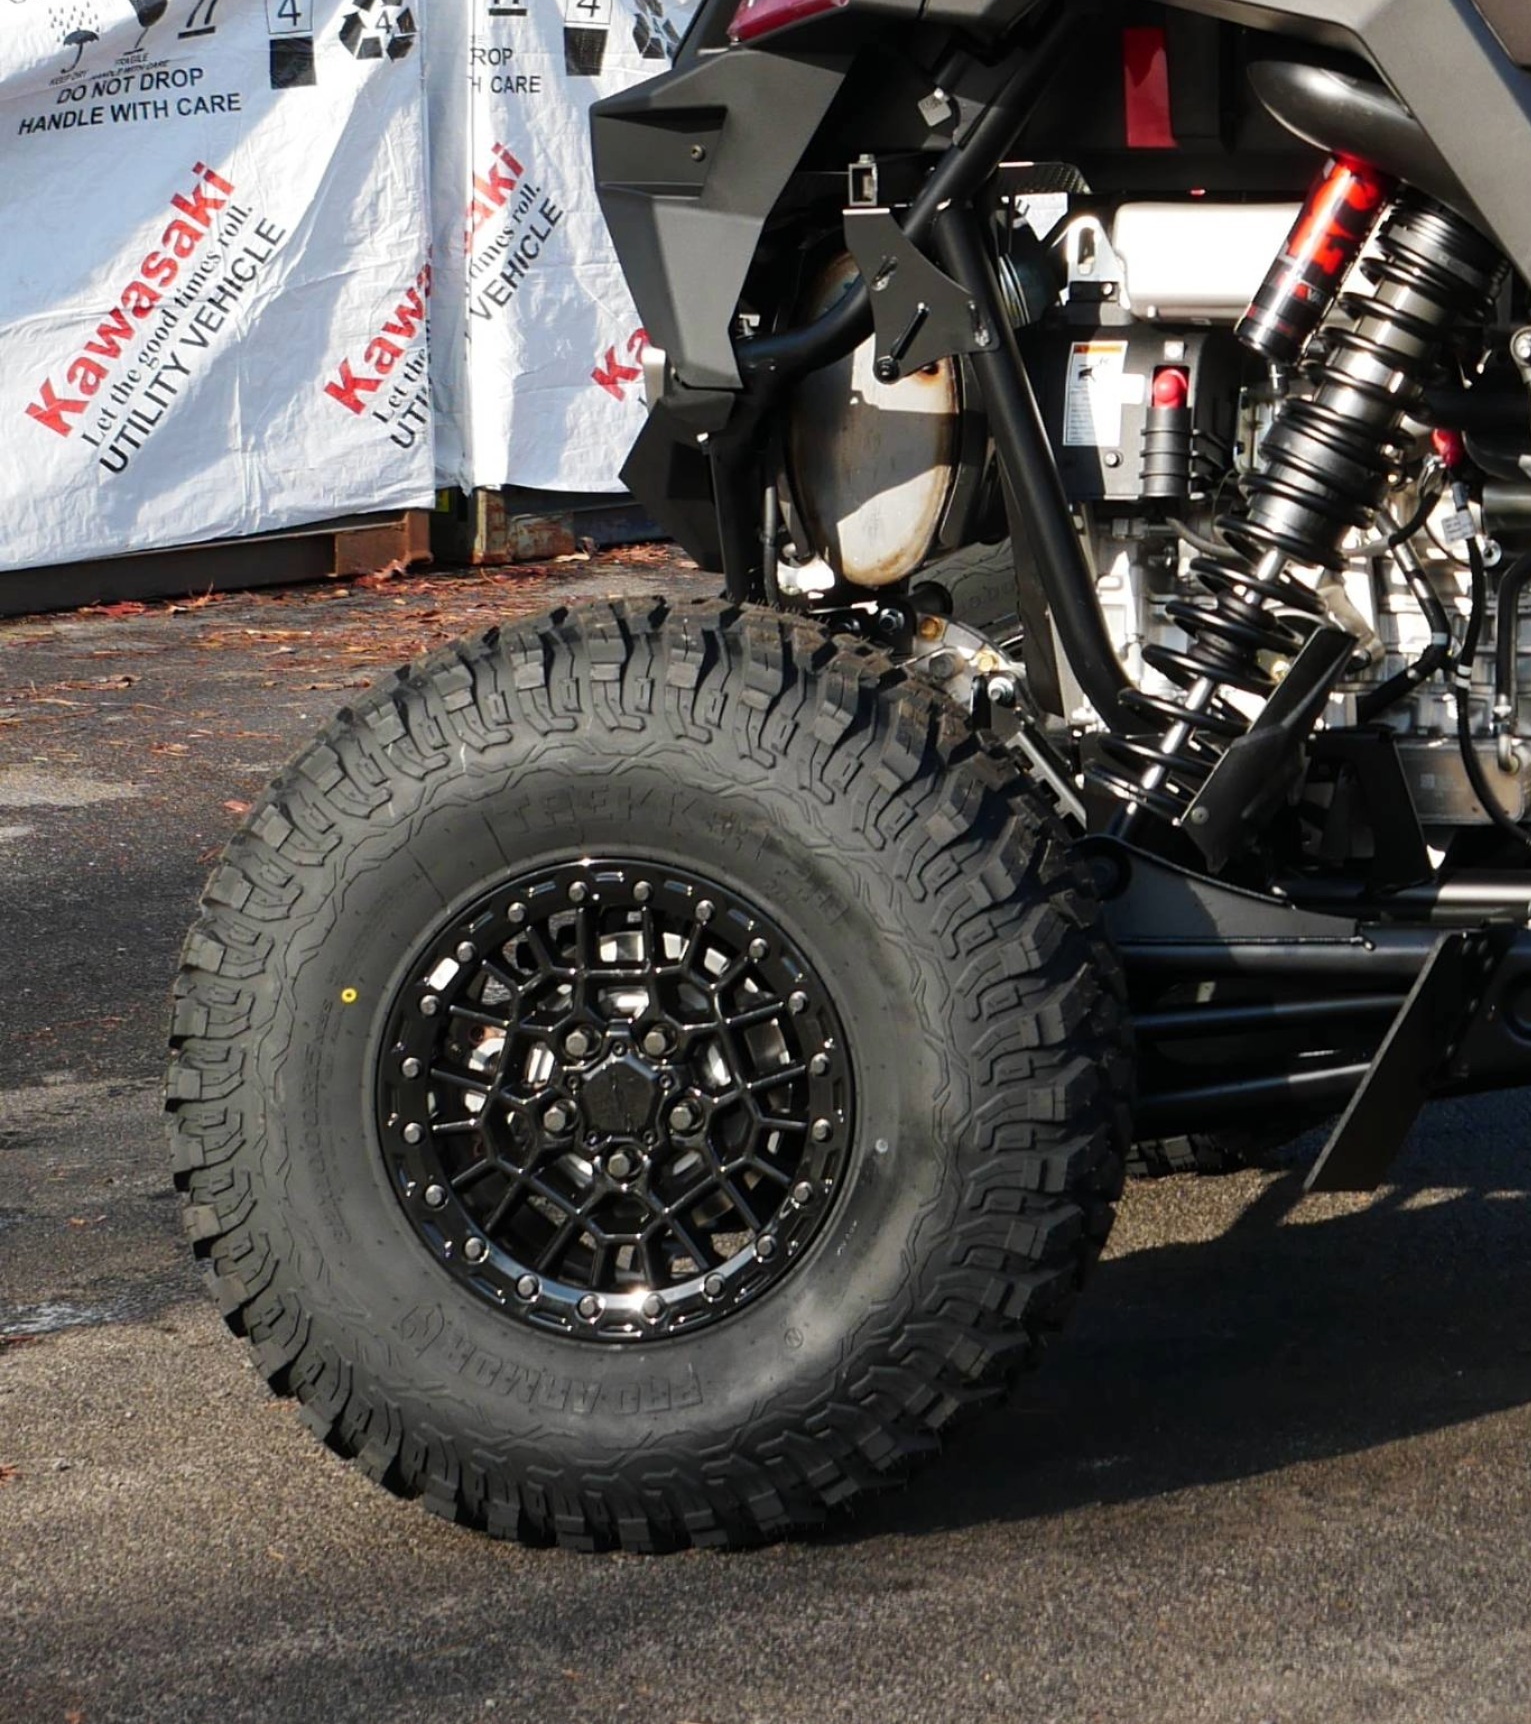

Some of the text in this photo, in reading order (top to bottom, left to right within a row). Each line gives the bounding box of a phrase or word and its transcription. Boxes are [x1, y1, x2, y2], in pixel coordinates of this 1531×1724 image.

[375, 9, 393, 34] 4
[56, 67, 204, 104] DO NOT DROP
[490, 75, 541, 94] CARE
[17, 92, 242, 135] HANDLE WITH CARE
[511, 183, 541, 227] roll.
[470, 198, 564, 320] VEHICLE
[24, 161, 235, 438] Kawasaki
[81, 205, 253, 447] Let the good times roll.
[99, 218, 286, 474] UTILITY VEHICLE
[372, 385, 406, 424] Let
